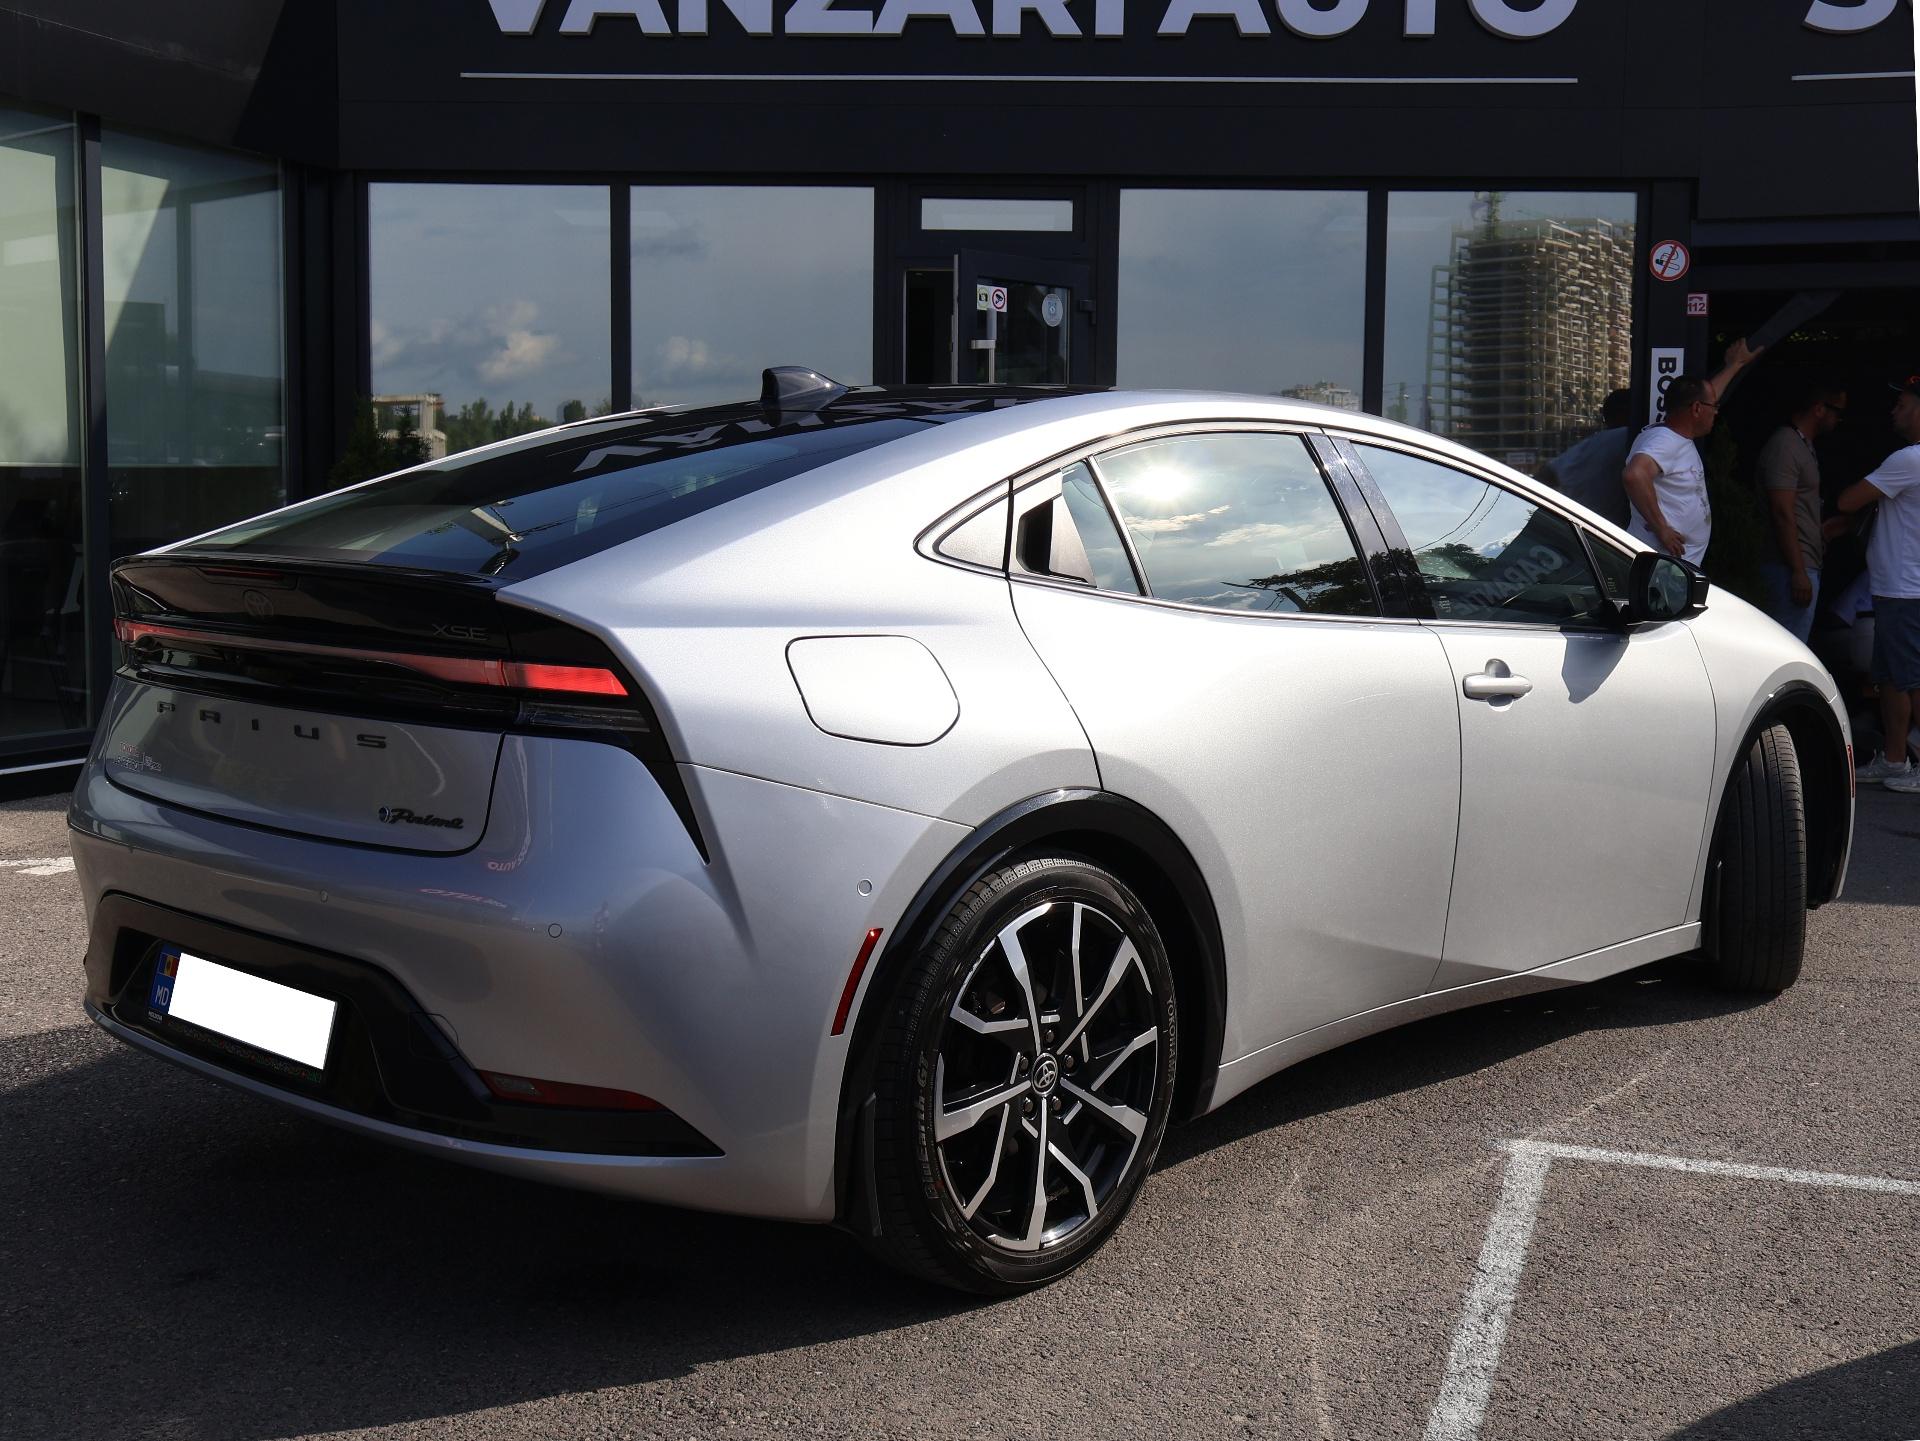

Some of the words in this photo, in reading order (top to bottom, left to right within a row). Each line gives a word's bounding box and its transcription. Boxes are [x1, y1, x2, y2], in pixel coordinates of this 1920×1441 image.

[1687, 302, 1706, 312] 112
[432, 623, 489, 641] XSE
[157, 701, 387, 749] PRIUS
[155, 984, 170, 1007] MD
[1166, 995, 1178, 1085] YOKOHAMA
